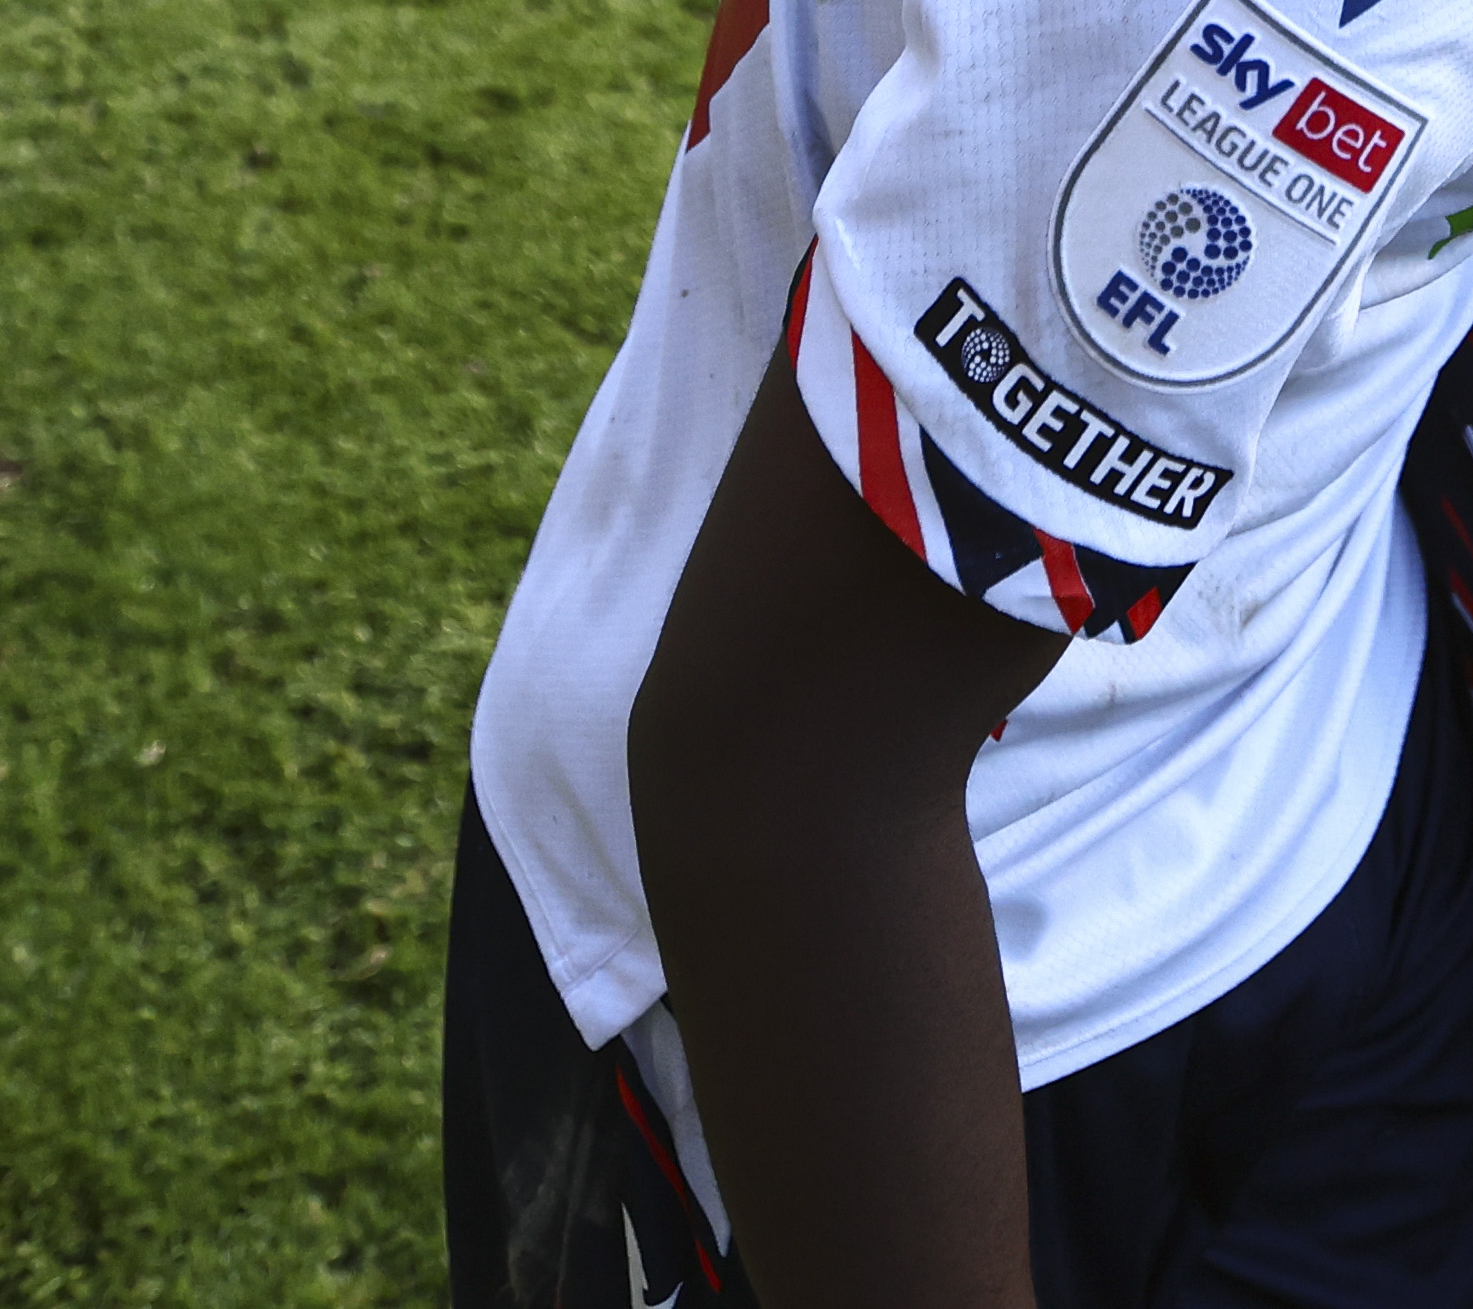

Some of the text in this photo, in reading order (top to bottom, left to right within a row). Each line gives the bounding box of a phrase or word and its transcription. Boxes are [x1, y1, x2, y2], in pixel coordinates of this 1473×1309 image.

[1160, 78, 1355, 231] LEAGUE ONE
[1190, 23, 1388, 173] sky bet
[1096, 269, 1181, 357] EFL
[934, 287, 1217, 519] TOGETHER
